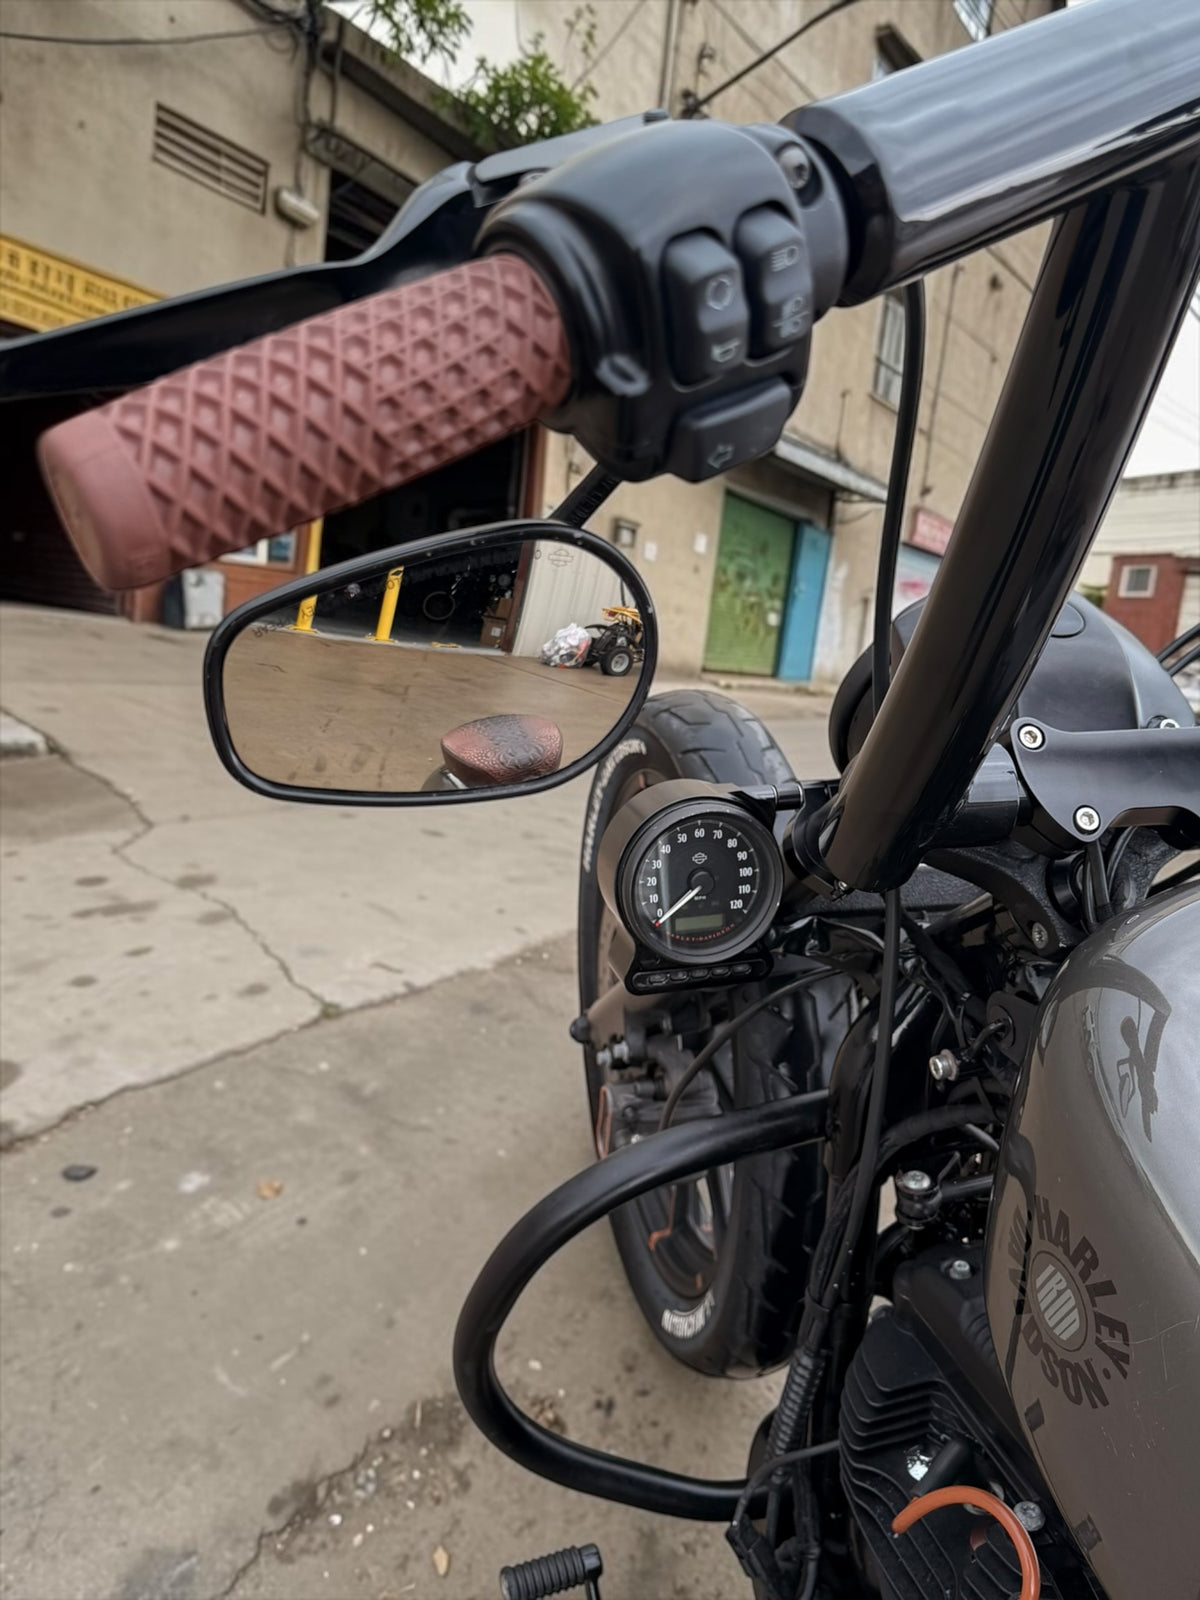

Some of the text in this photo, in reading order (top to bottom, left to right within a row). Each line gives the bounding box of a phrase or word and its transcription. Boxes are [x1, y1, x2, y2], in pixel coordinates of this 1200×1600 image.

[677, 833, 687, 843] 50
[694, 828, 705, 838] 60
[713, 829, 723, 839] 70
[727, 838, 737, 848] 80
[660, 844, 671, 854] 40
[737, 851, 747, 861] 90
[652, 860, 661, 870] 30
[739, 867, 753, 877] 100
[646, 876, 657, 886] 20
[738, 884, 751, 894] 110
[649, 894, 658, 903] 10
[730, 899, 743, 909] 120
[657, 908, 663, 917] 0
[1036, 1263, 1081, 1341] IRON
